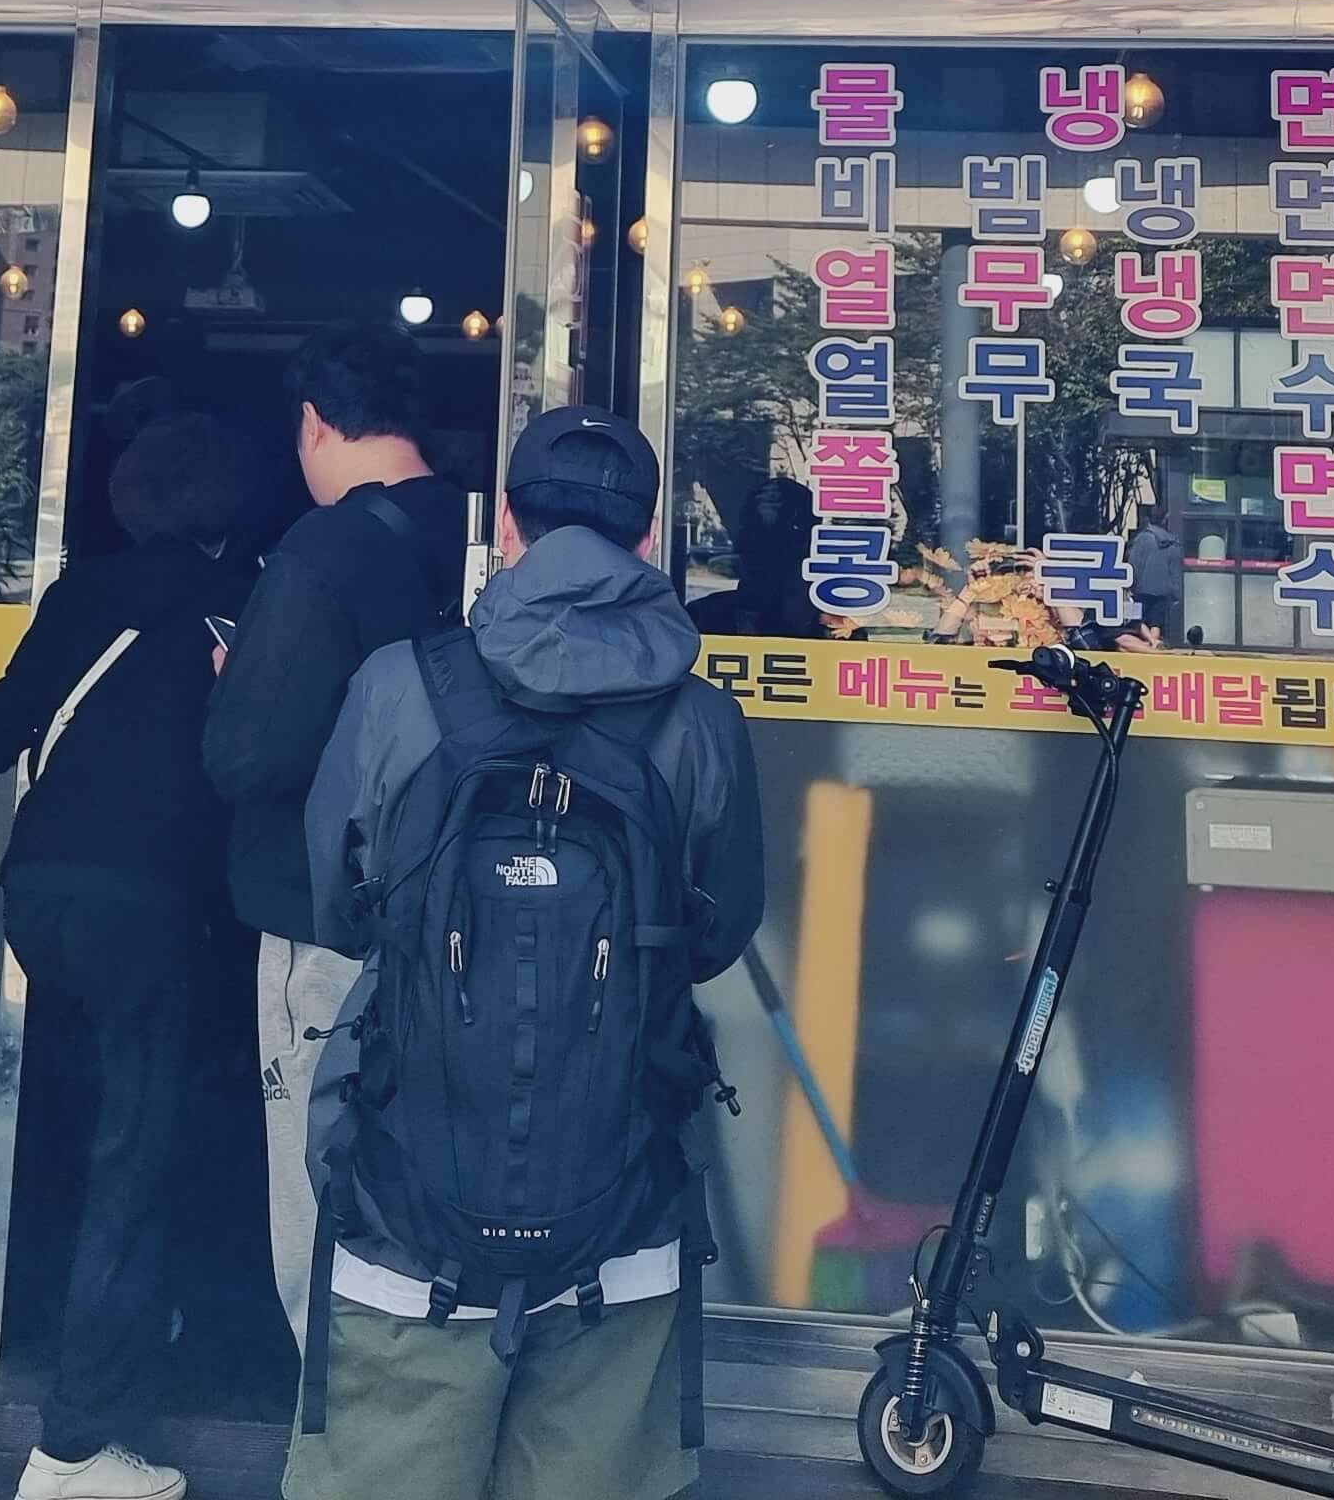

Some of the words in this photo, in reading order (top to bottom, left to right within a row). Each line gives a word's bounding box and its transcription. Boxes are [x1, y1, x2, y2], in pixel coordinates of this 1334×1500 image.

[707, 651, 814, 706] 모든
[838, 657, 988, 713] 메뉴는
[511, 856, 537, 867] THE
[495, 863, 536, 877] NORTH
[505, 875, 537, 886] FACE
